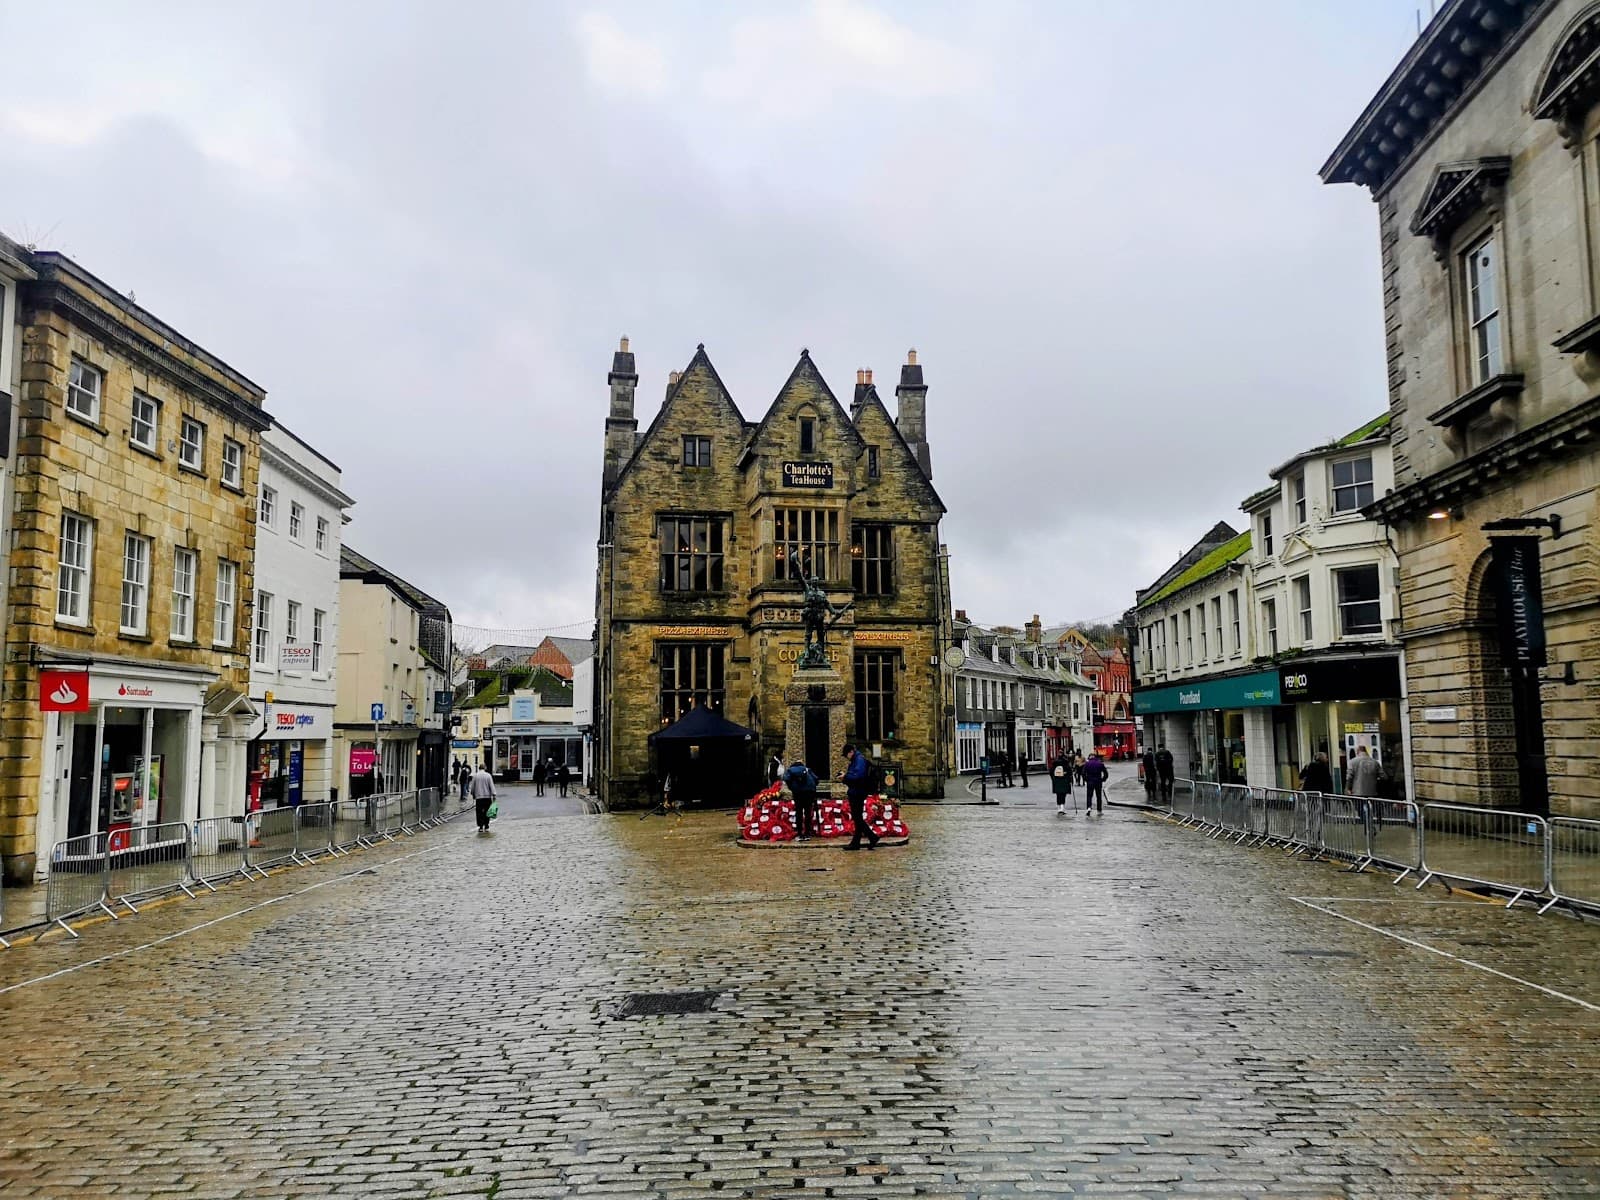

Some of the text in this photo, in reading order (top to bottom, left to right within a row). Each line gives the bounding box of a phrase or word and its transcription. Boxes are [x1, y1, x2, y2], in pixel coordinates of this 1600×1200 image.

[784, 463, 832, 476] Charlotte's
[1511, 574, 1530, 660] PLAYHOUSE
[282, 657, 310, 665] express
[126, 685, 153, 697] Santander
[276, 713, 296, 725] TESCO
[352, 762, 363, 770] To
